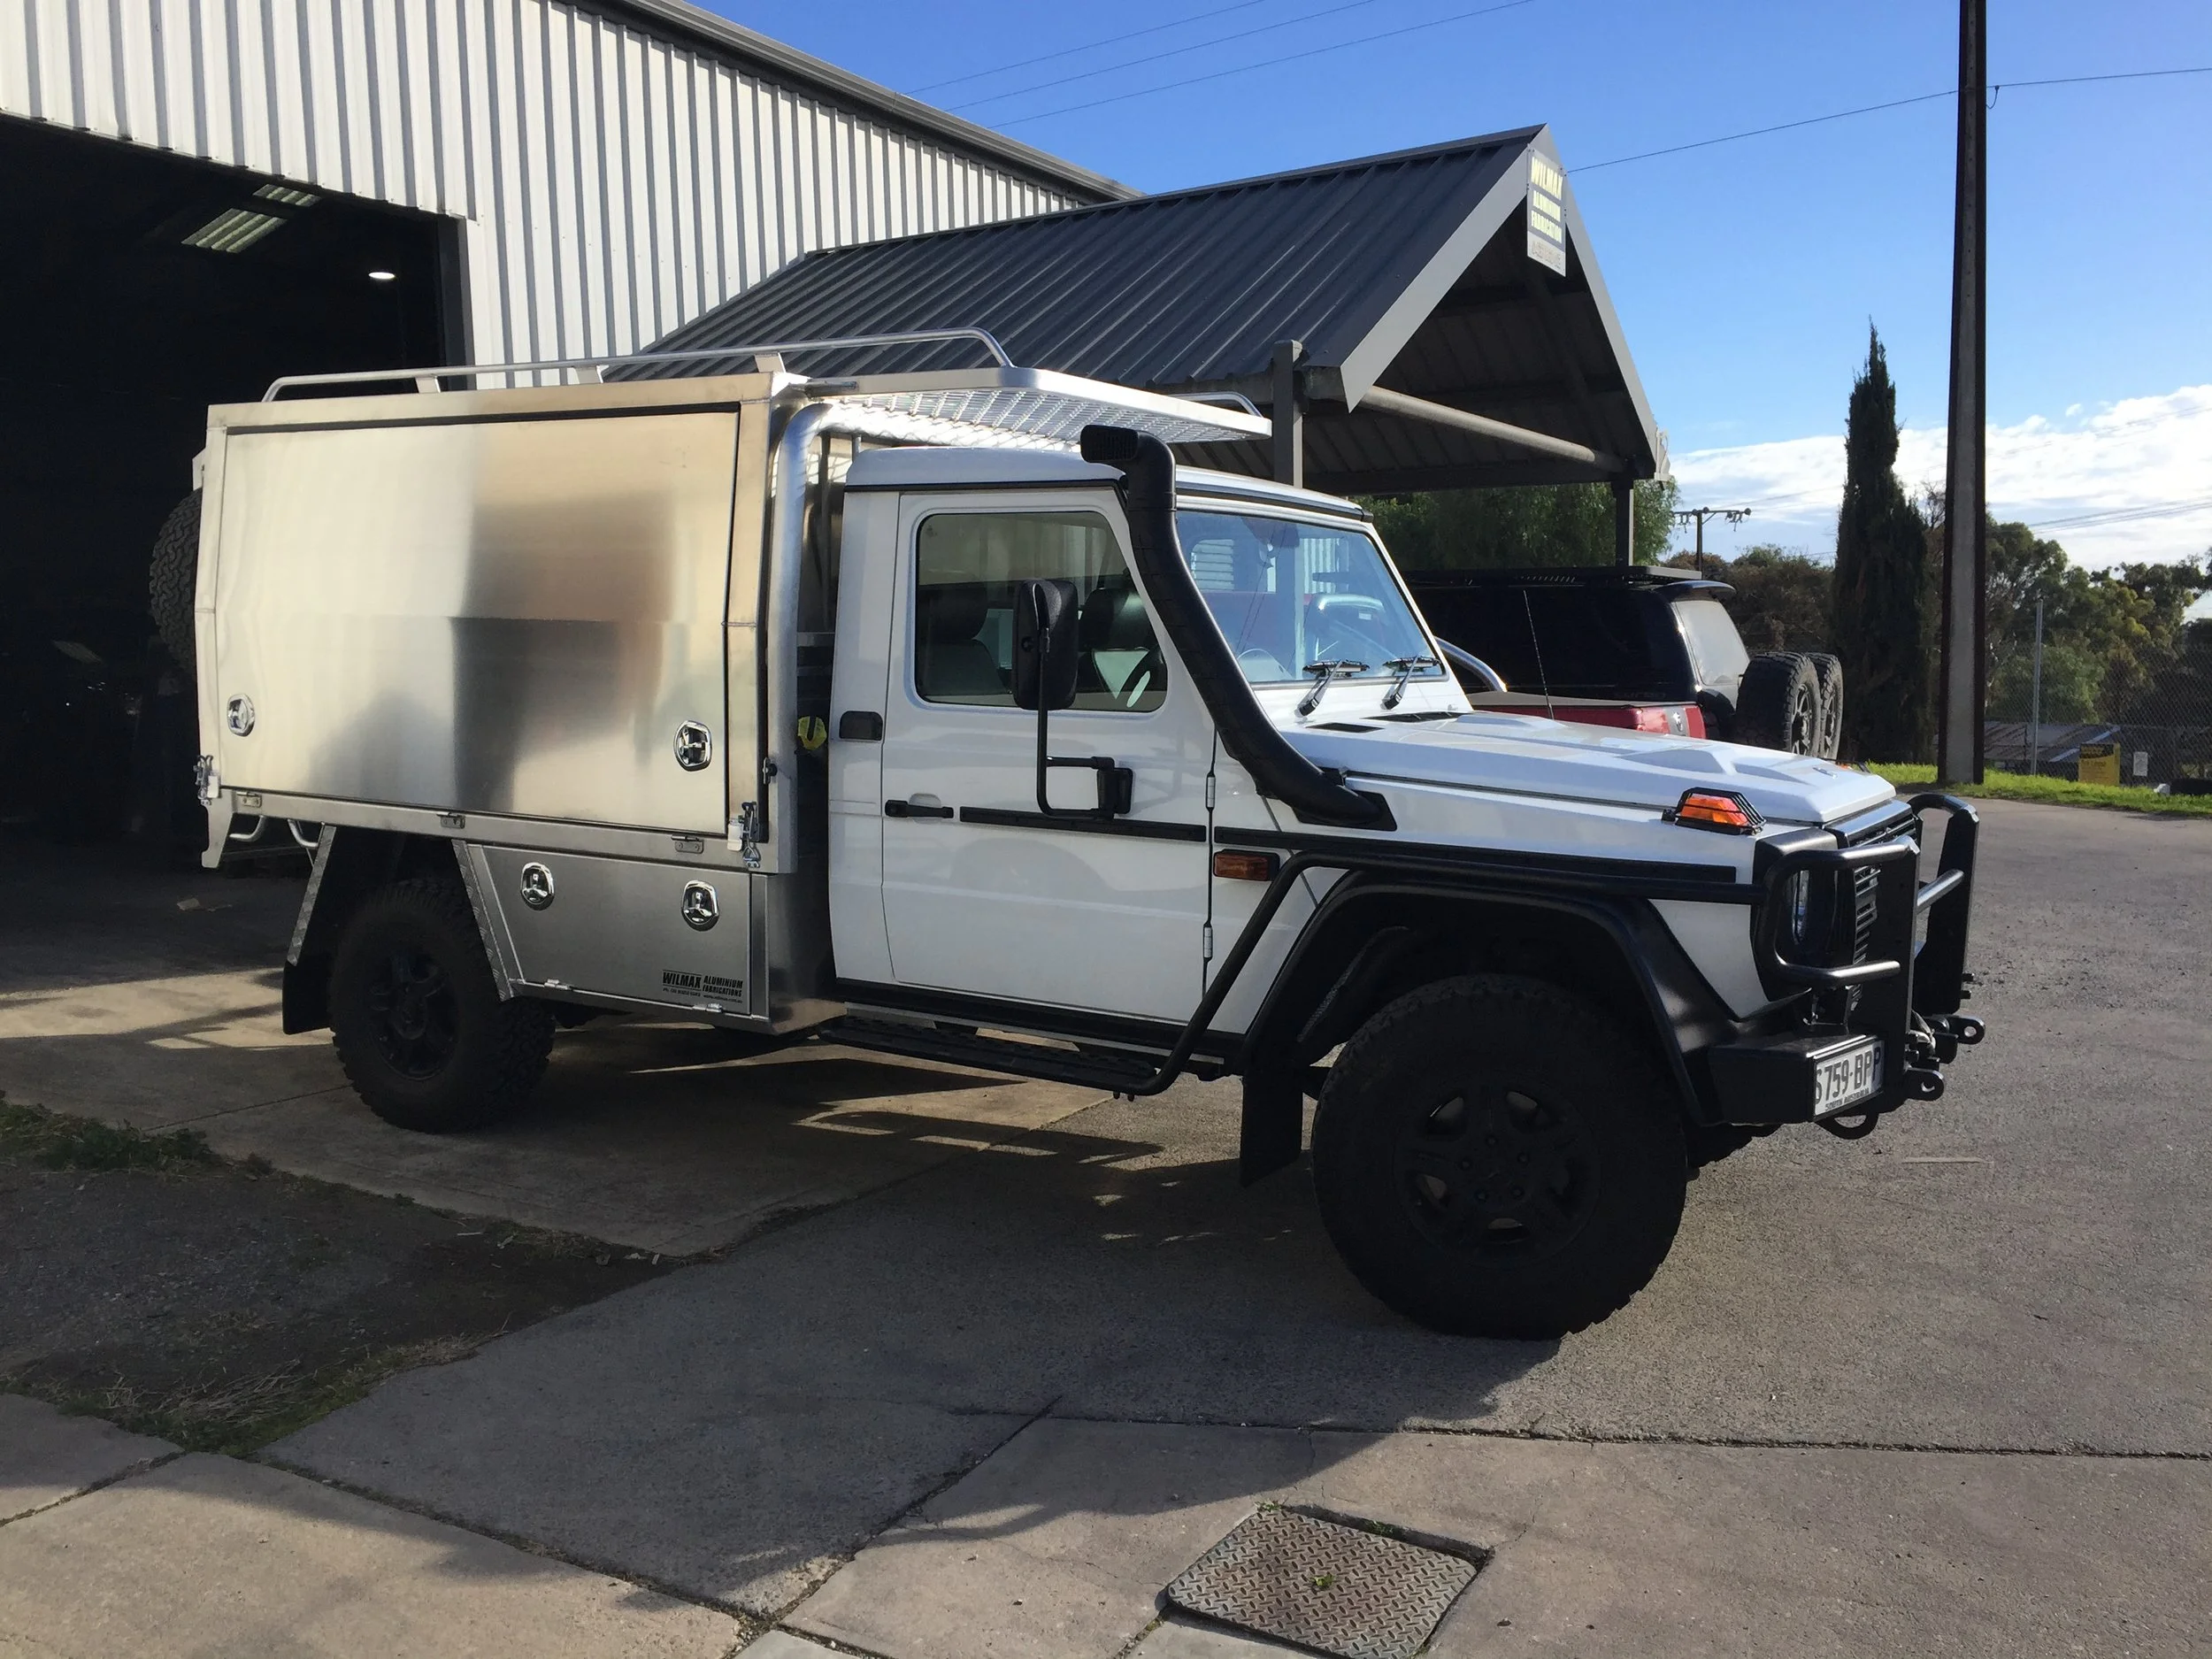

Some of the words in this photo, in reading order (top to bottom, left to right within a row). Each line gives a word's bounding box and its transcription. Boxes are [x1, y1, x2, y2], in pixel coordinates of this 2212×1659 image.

[1531, 157, 1563, 200] WILMAX
[663, 972, 702, 988] WILMAX
[703, 975, 743, 989] ALUMINIUM
[703, 985, 742, 997] FABRICATIONS
